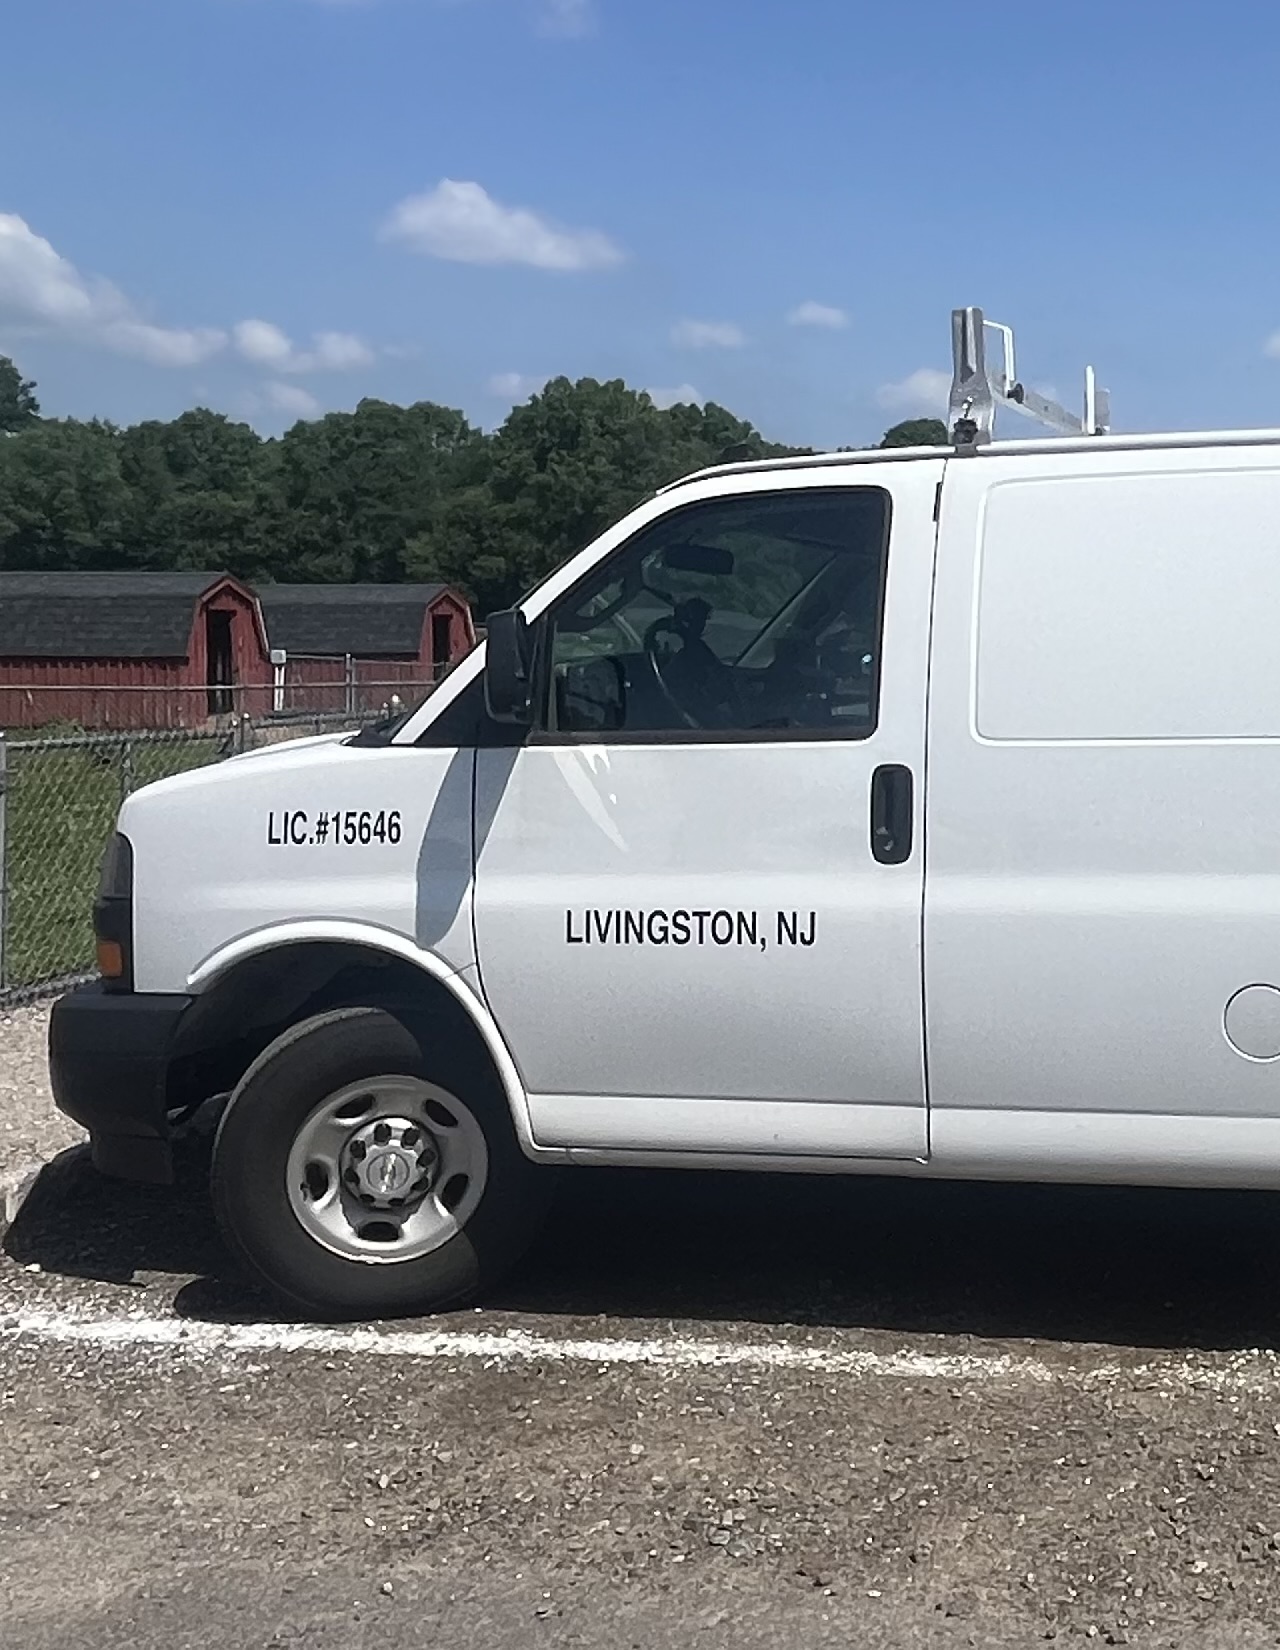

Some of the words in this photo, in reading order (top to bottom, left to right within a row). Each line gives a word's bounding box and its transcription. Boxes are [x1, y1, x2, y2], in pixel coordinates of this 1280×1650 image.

[267, 811, 402, 845] LIC.#15646
[566, 910, 768, 951] LIVINGSTON,
[777, 911, 817, 946] NJ
